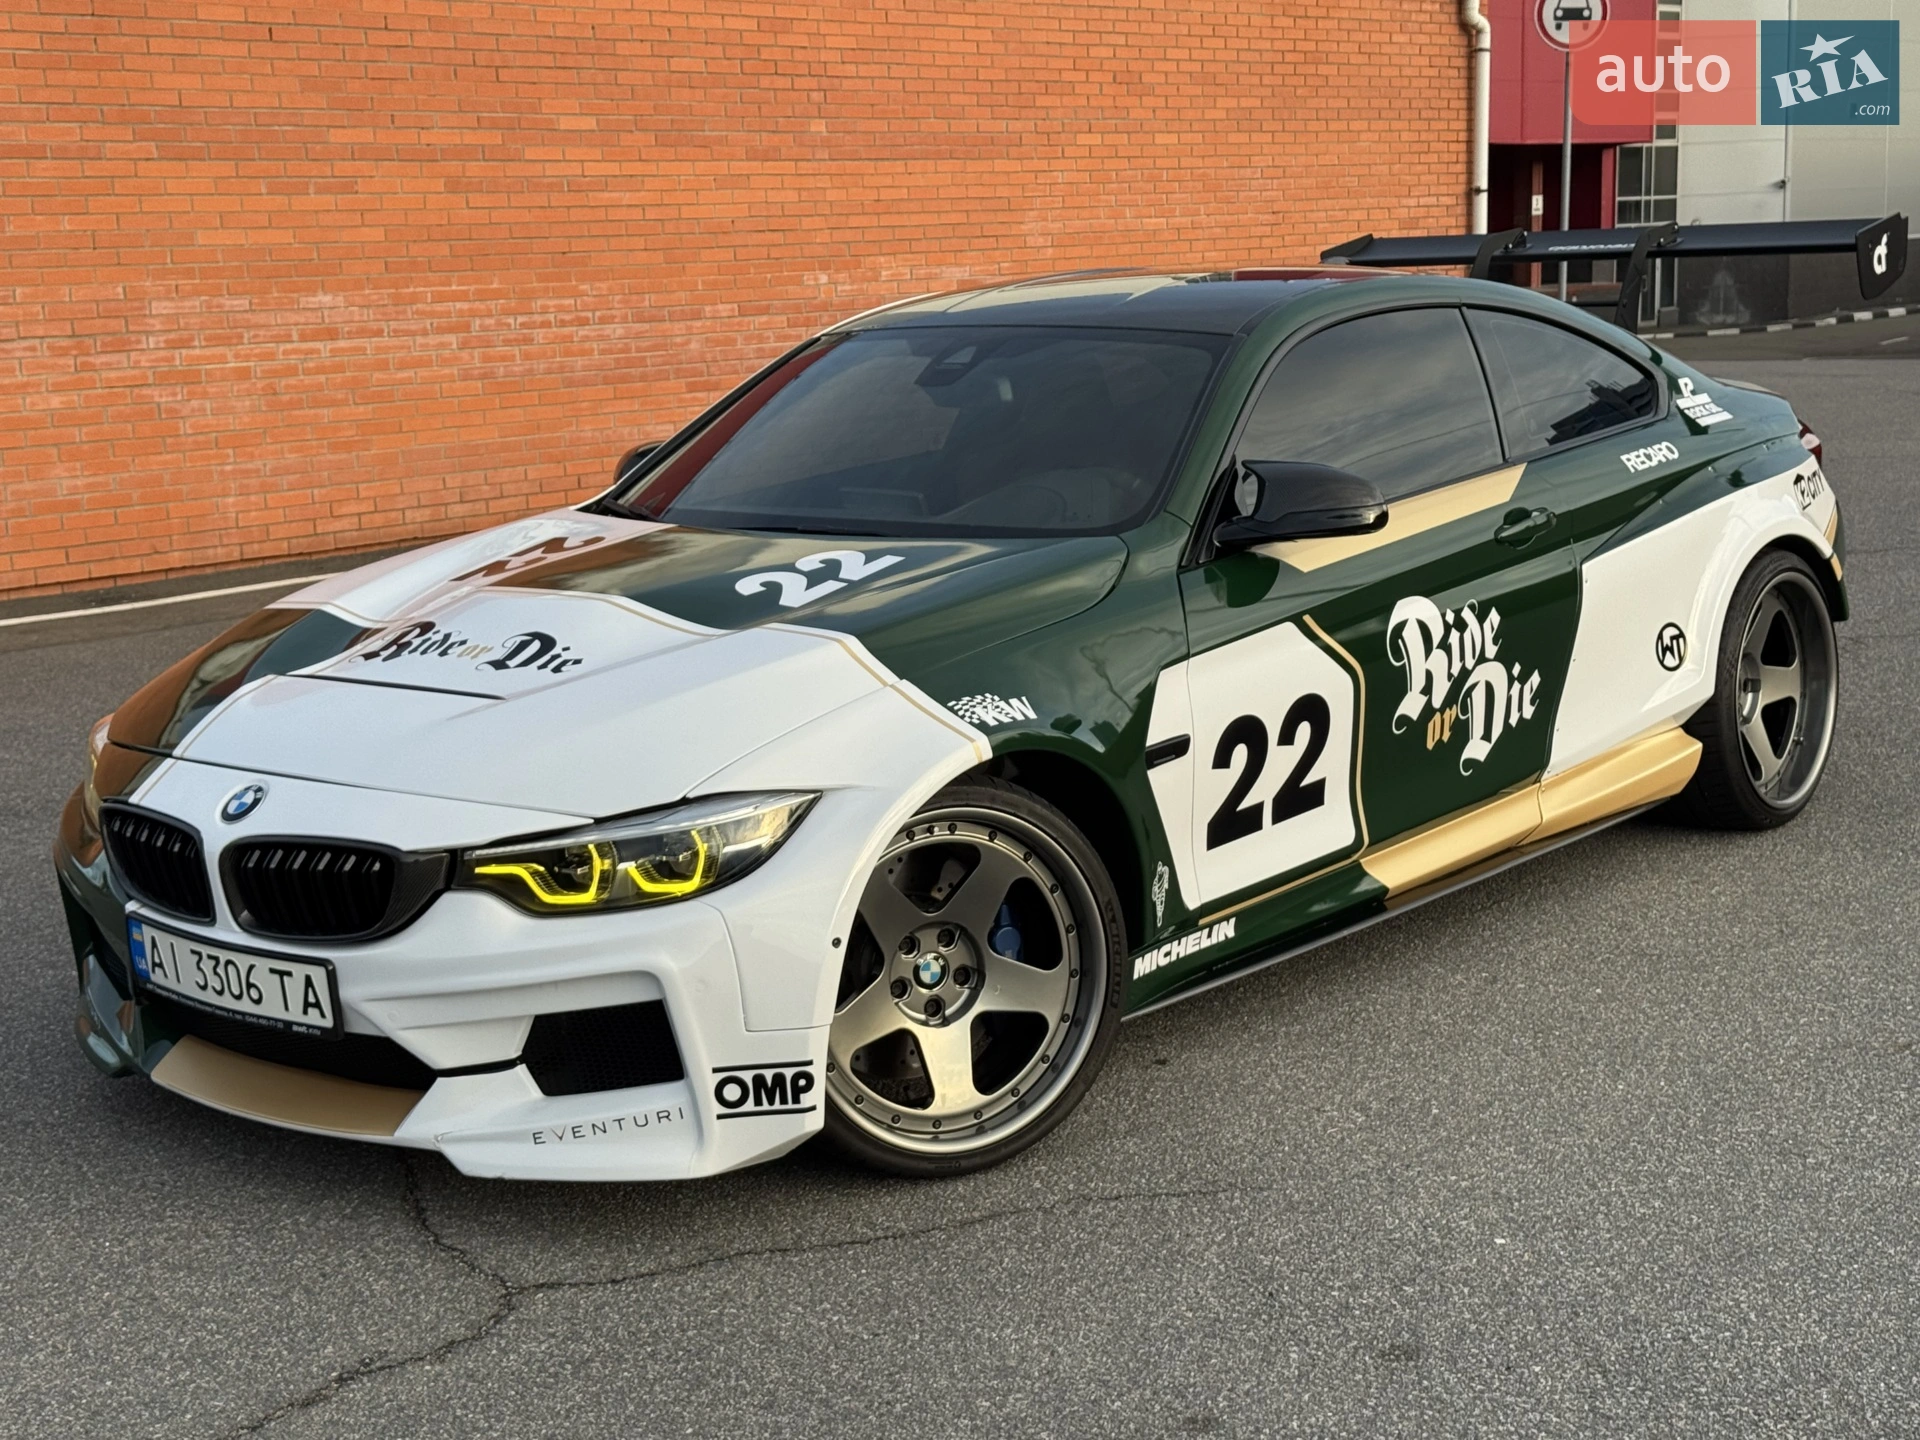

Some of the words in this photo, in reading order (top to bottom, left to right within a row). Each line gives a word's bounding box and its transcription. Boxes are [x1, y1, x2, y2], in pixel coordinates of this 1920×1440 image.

[1620, 441, 1679, 473] RECARO
[1808, 467, 1825, 500] CITY
[735, 550, 906, 608] 22
[456, 642, 494, 660] or
[475, 630, 583, 674] Die
[1386, 595, 1502, 734] Ride
[973, 695, 1038, 727] KW
[1426, 704, 1458, 751] or
[1458, 660, 1541, 776] Die
[1206, 692, 1331, 851] 22
[136, 955, 149, 970] UA
[1133, 917, 1237, 981] MICHELIN
[151, 935, 181, 984] AI
[189, 948, 264, 1005] 3306
[268, 966, 327, 1019] TA
[714, 1069, 815, 1110] OMP
[532, 1106, 685, 1146] EVENTURI
